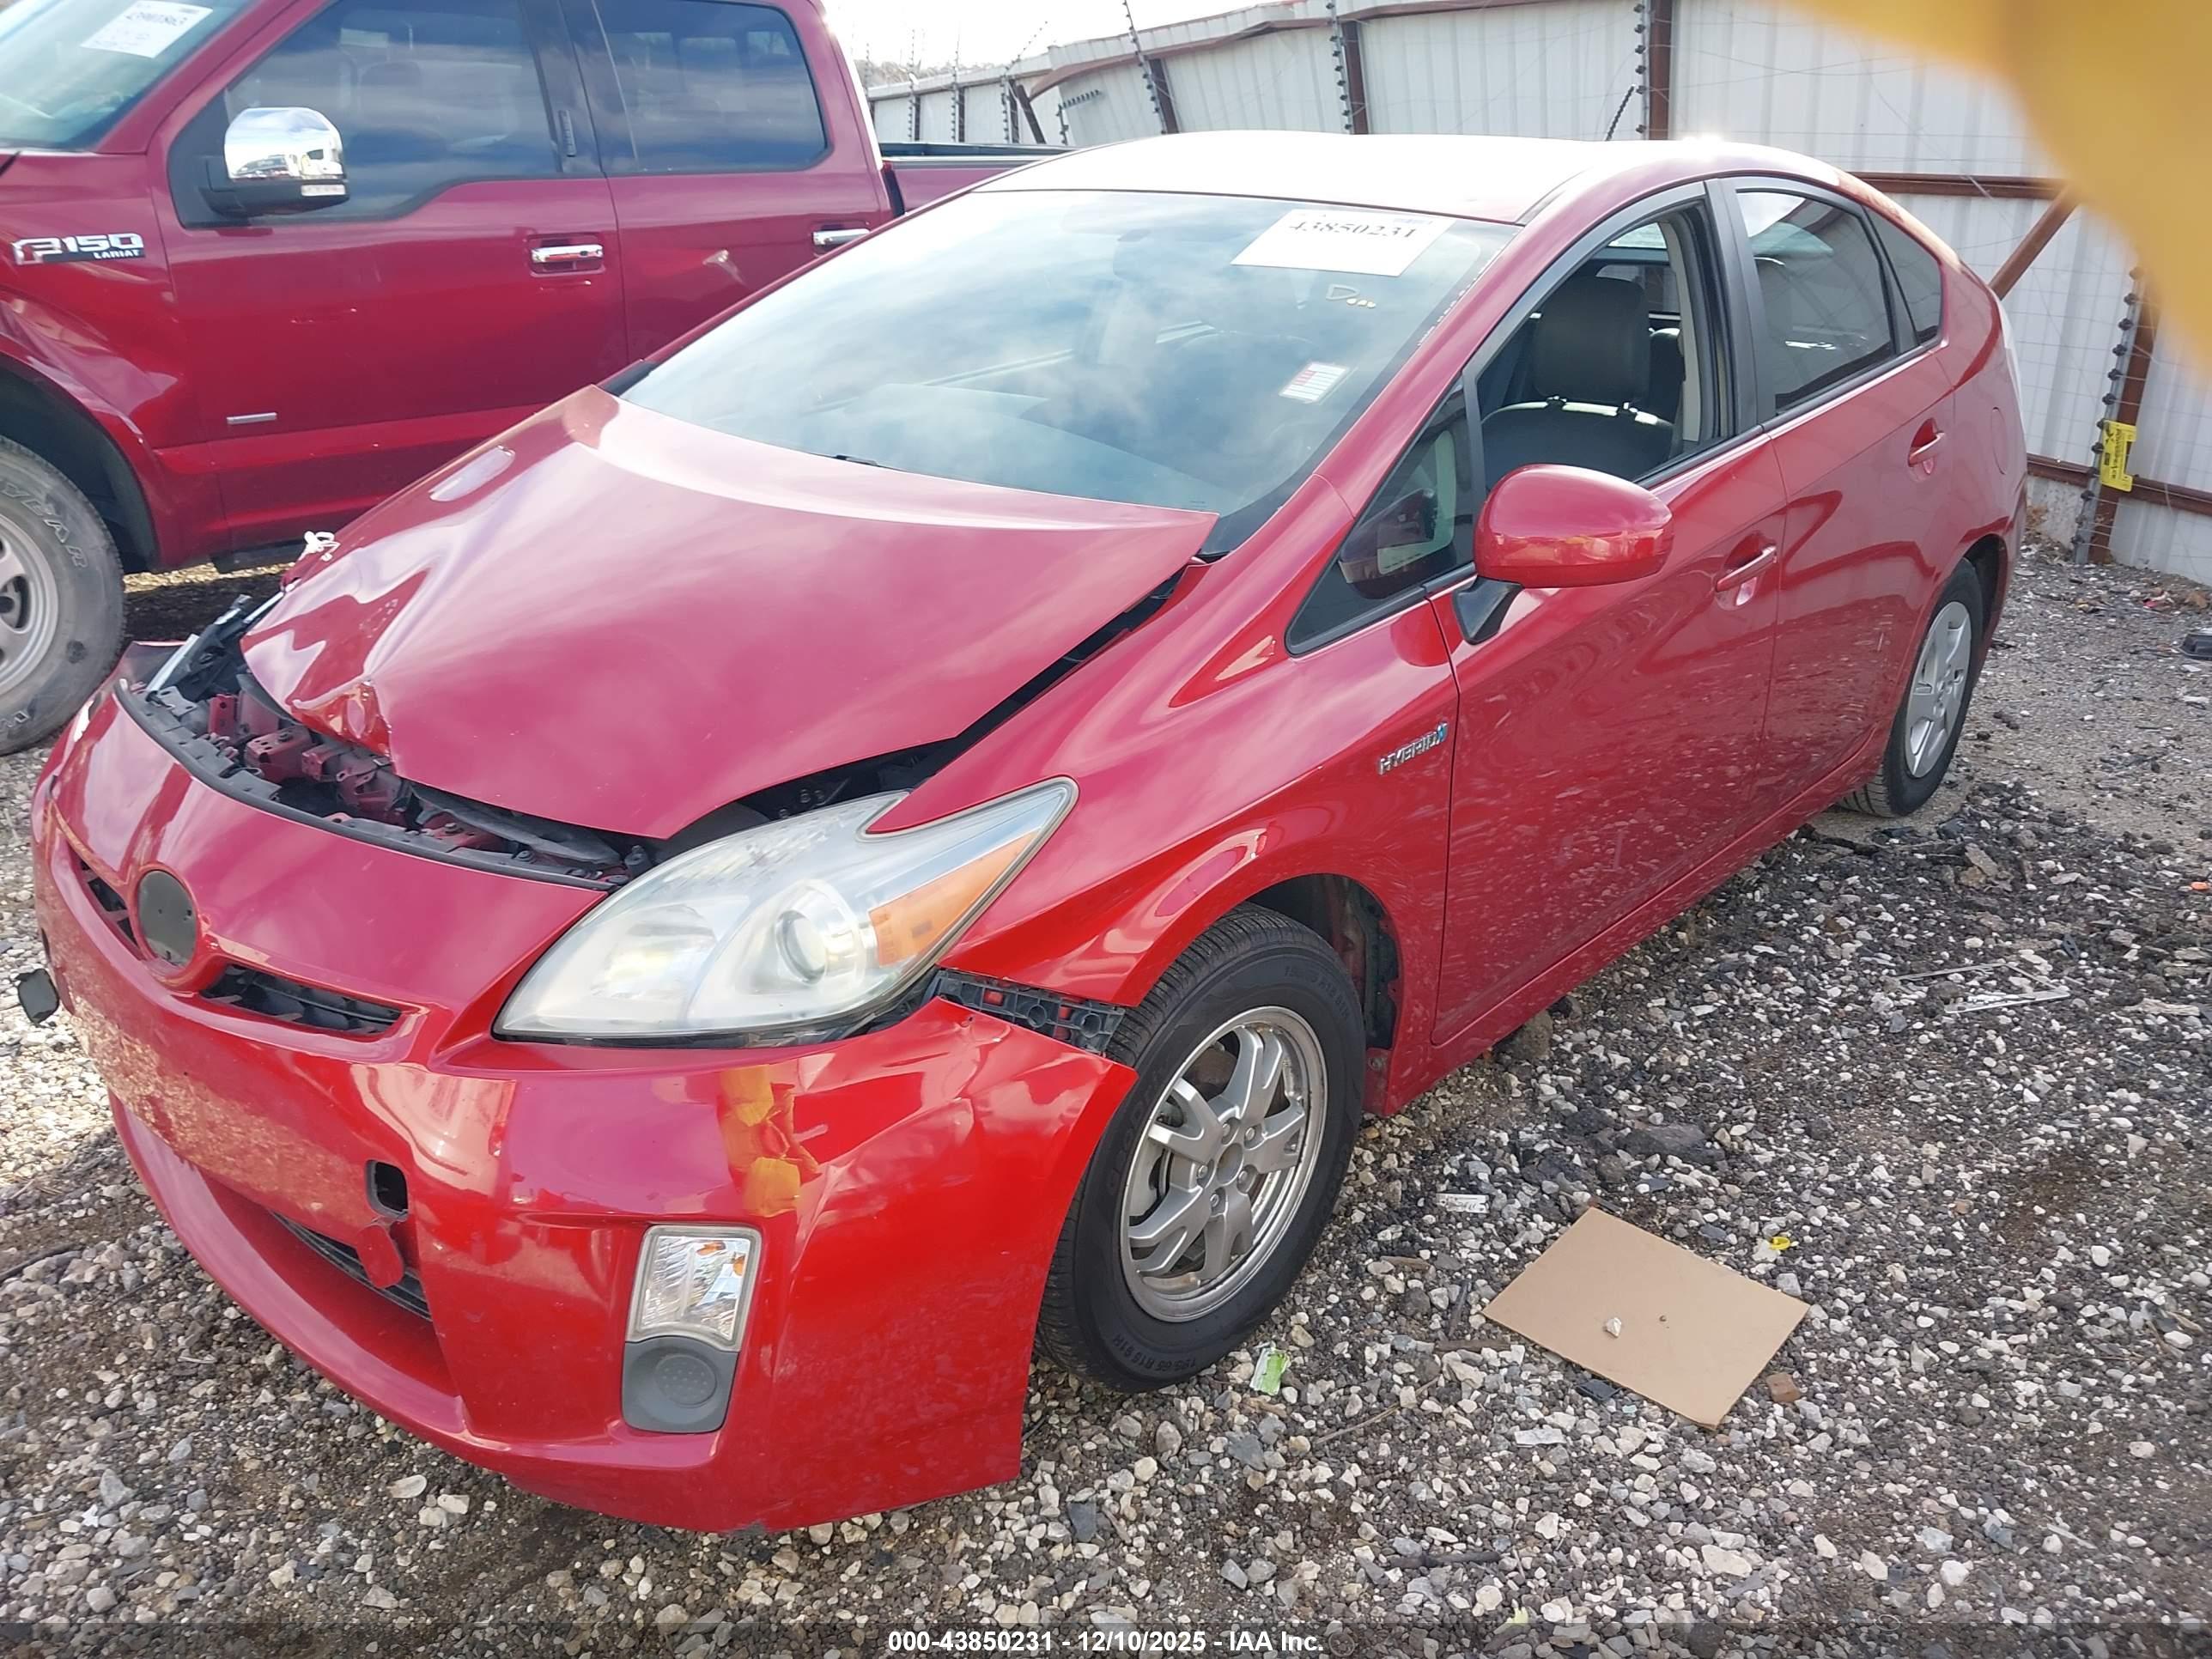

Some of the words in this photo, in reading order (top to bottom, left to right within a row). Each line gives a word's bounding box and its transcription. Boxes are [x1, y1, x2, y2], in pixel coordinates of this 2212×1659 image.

[1290, 221, 1417, 238] 43850231
[93, 249, 139, 259] LARIAT
[1379, 731, 1441, 775] HYBRID
